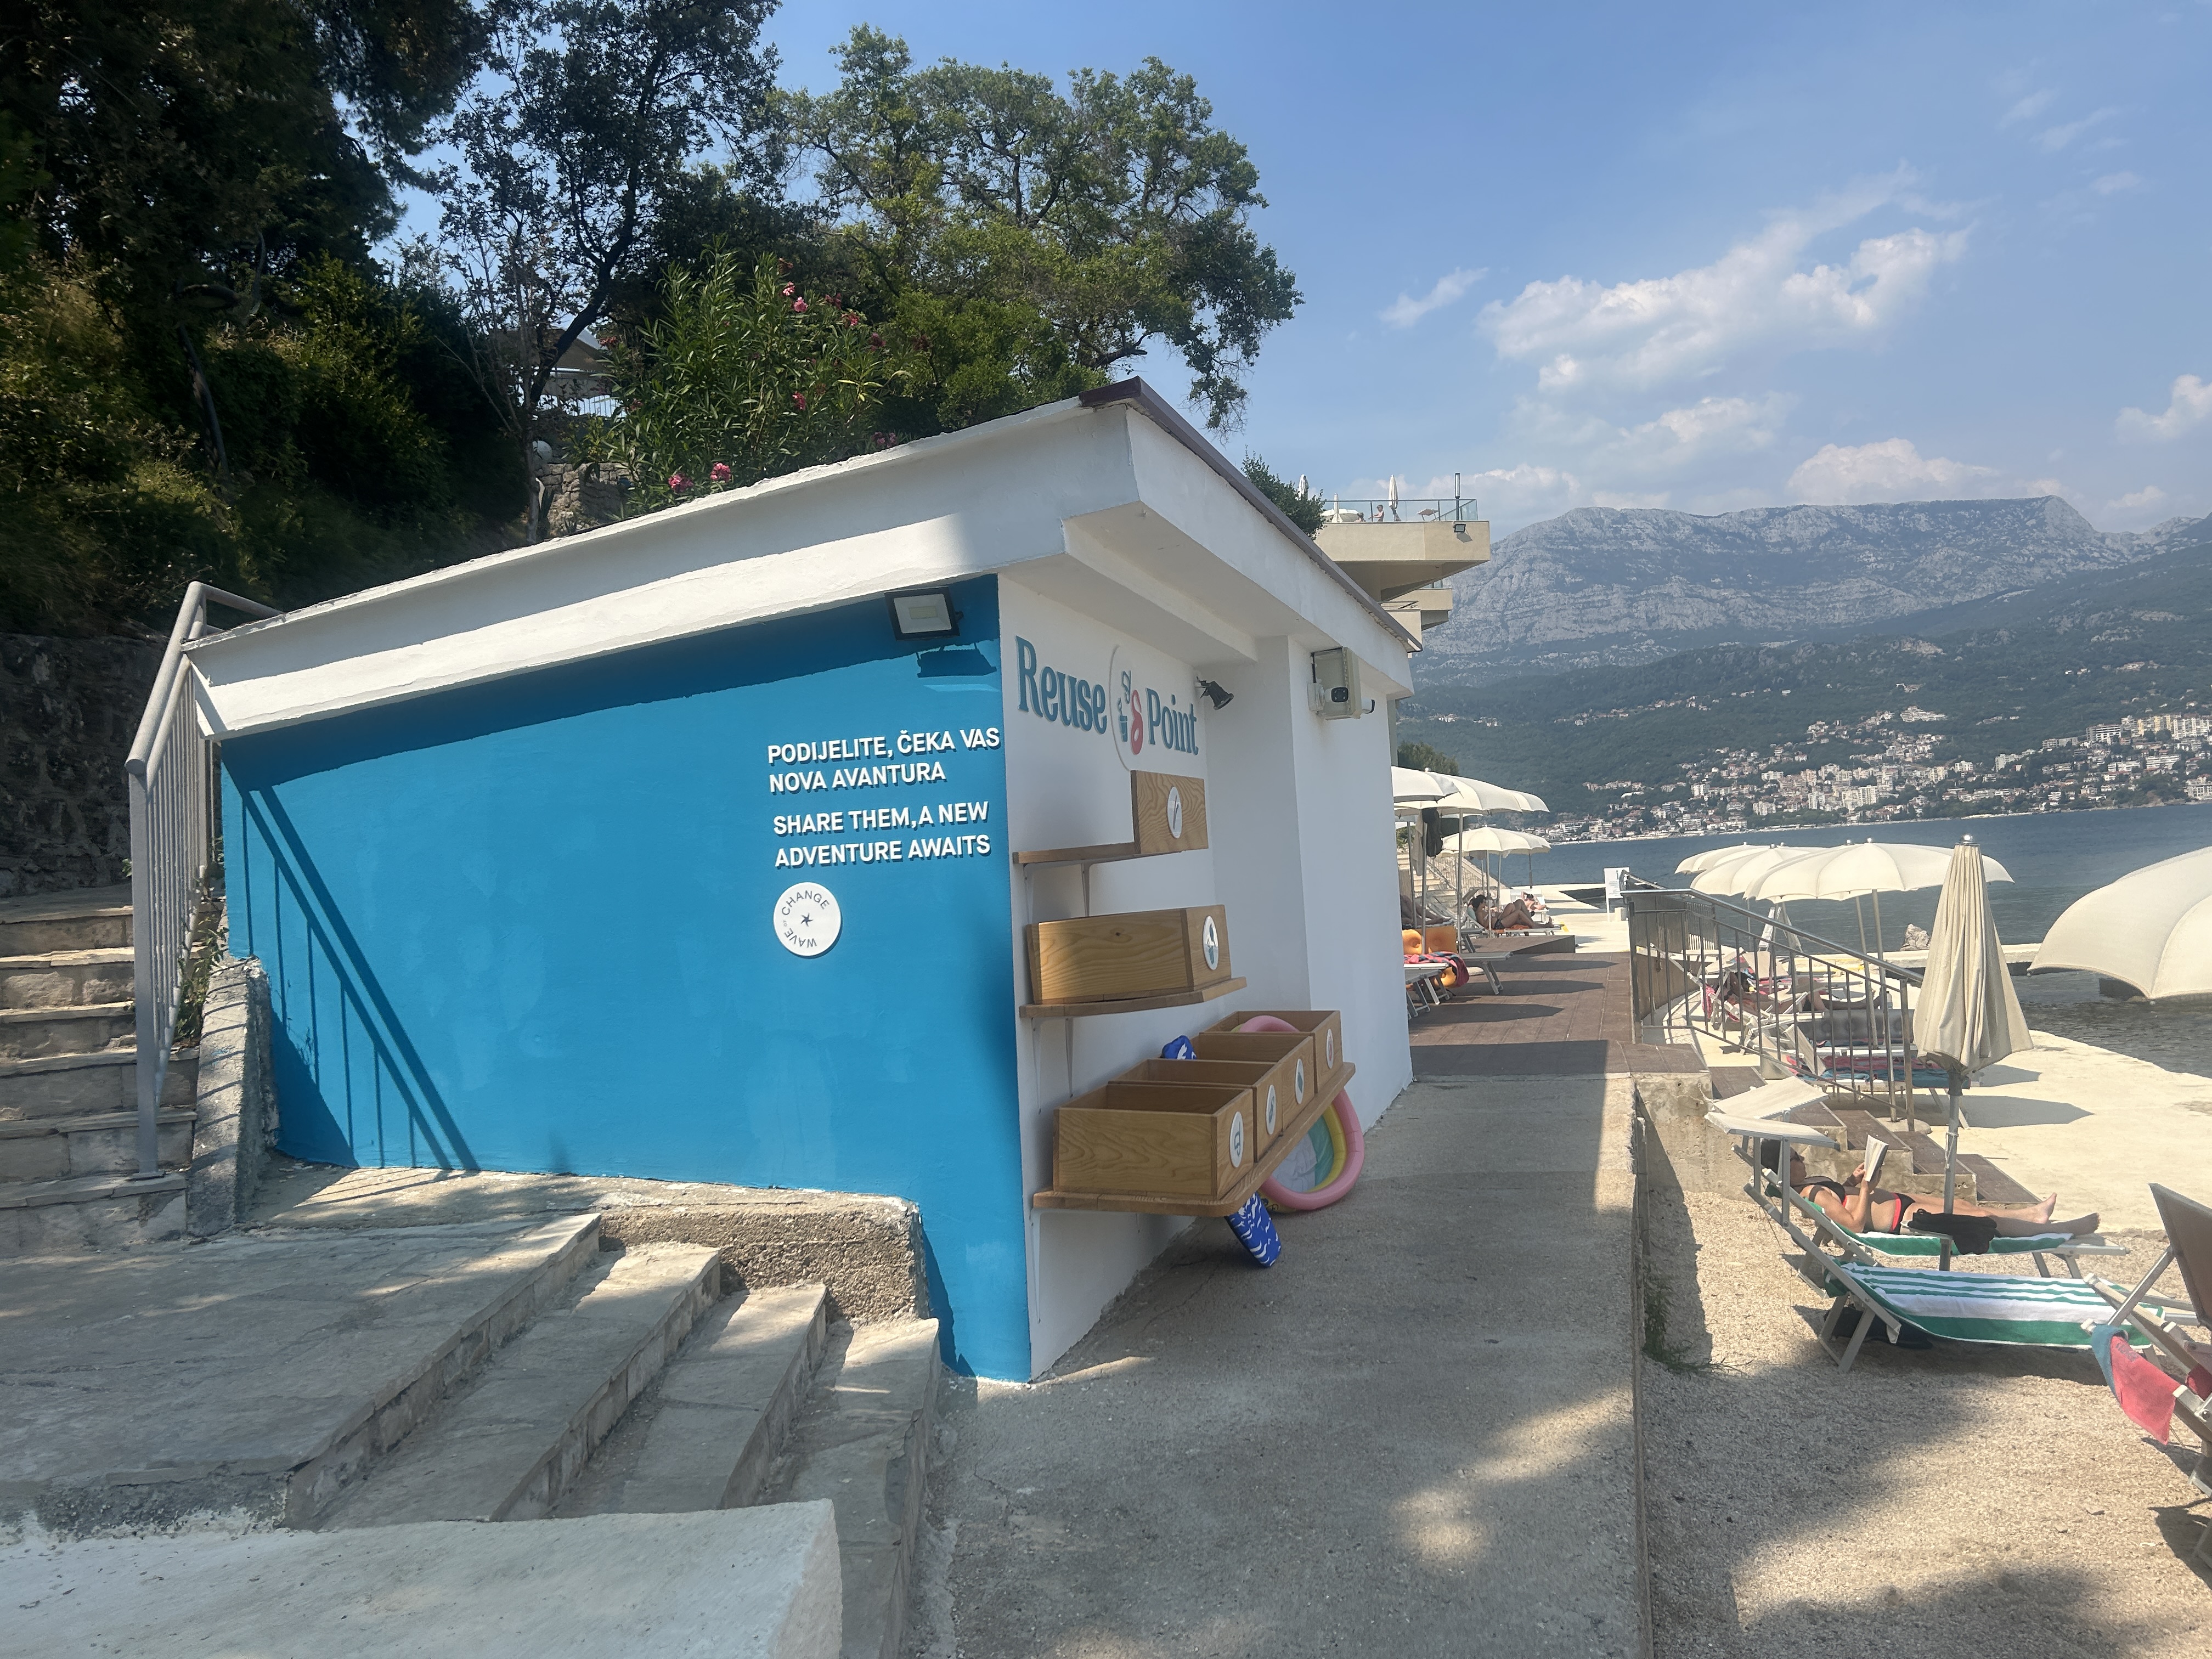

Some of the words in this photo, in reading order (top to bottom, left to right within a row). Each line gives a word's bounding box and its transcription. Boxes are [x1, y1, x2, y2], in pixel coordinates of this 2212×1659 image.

[1015, 636, 1107, 734] Reuse
[1146, 688, 1199, 755] Point
[768, 736, 893, 764] PODIJELITE,
[897, 730, 956, 753] ČEKA
[960, 727, 1000, 748] VAS
[769, 770, 827, 792] NOVA
[832, 761, 946, 788] AVANTURA
[774, 811, 844, 834] SHARE
[938, 801, 989, 822] NEW
[775, 840, 902, 867] ADVENTURE
[907, 834, 990, 859] AWAITS
[781, 890, 830, 916] CHANGE
[784, 928, 817, 949] WAVE
